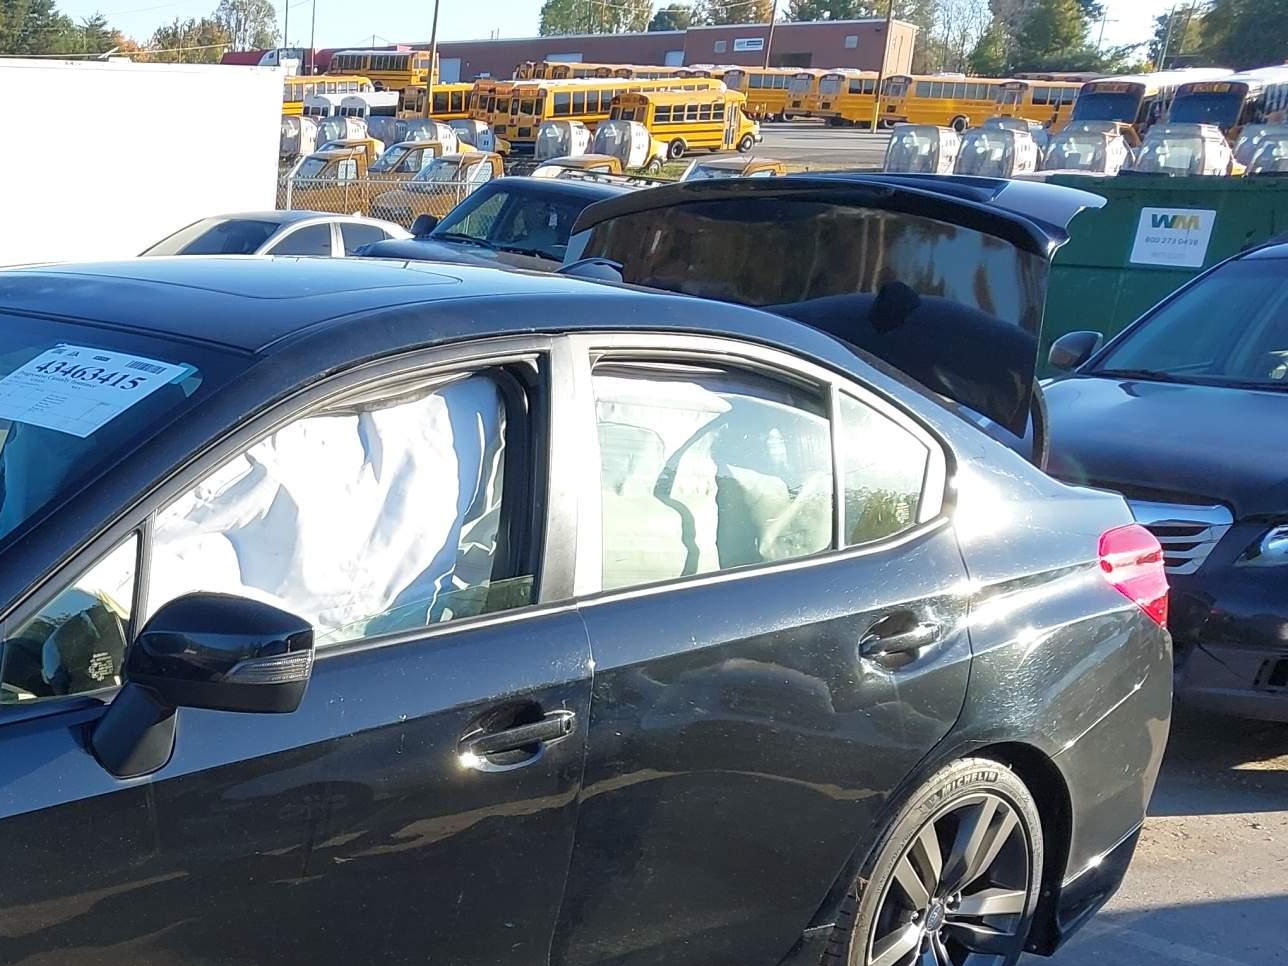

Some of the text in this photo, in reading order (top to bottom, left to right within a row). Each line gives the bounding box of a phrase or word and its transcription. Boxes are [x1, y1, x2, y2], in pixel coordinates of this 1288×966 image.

[1151, 214, 1200, 230] WM
[35, 359, 148, 391] 43463415
[942, 771, 997, 798] MICHELIN
